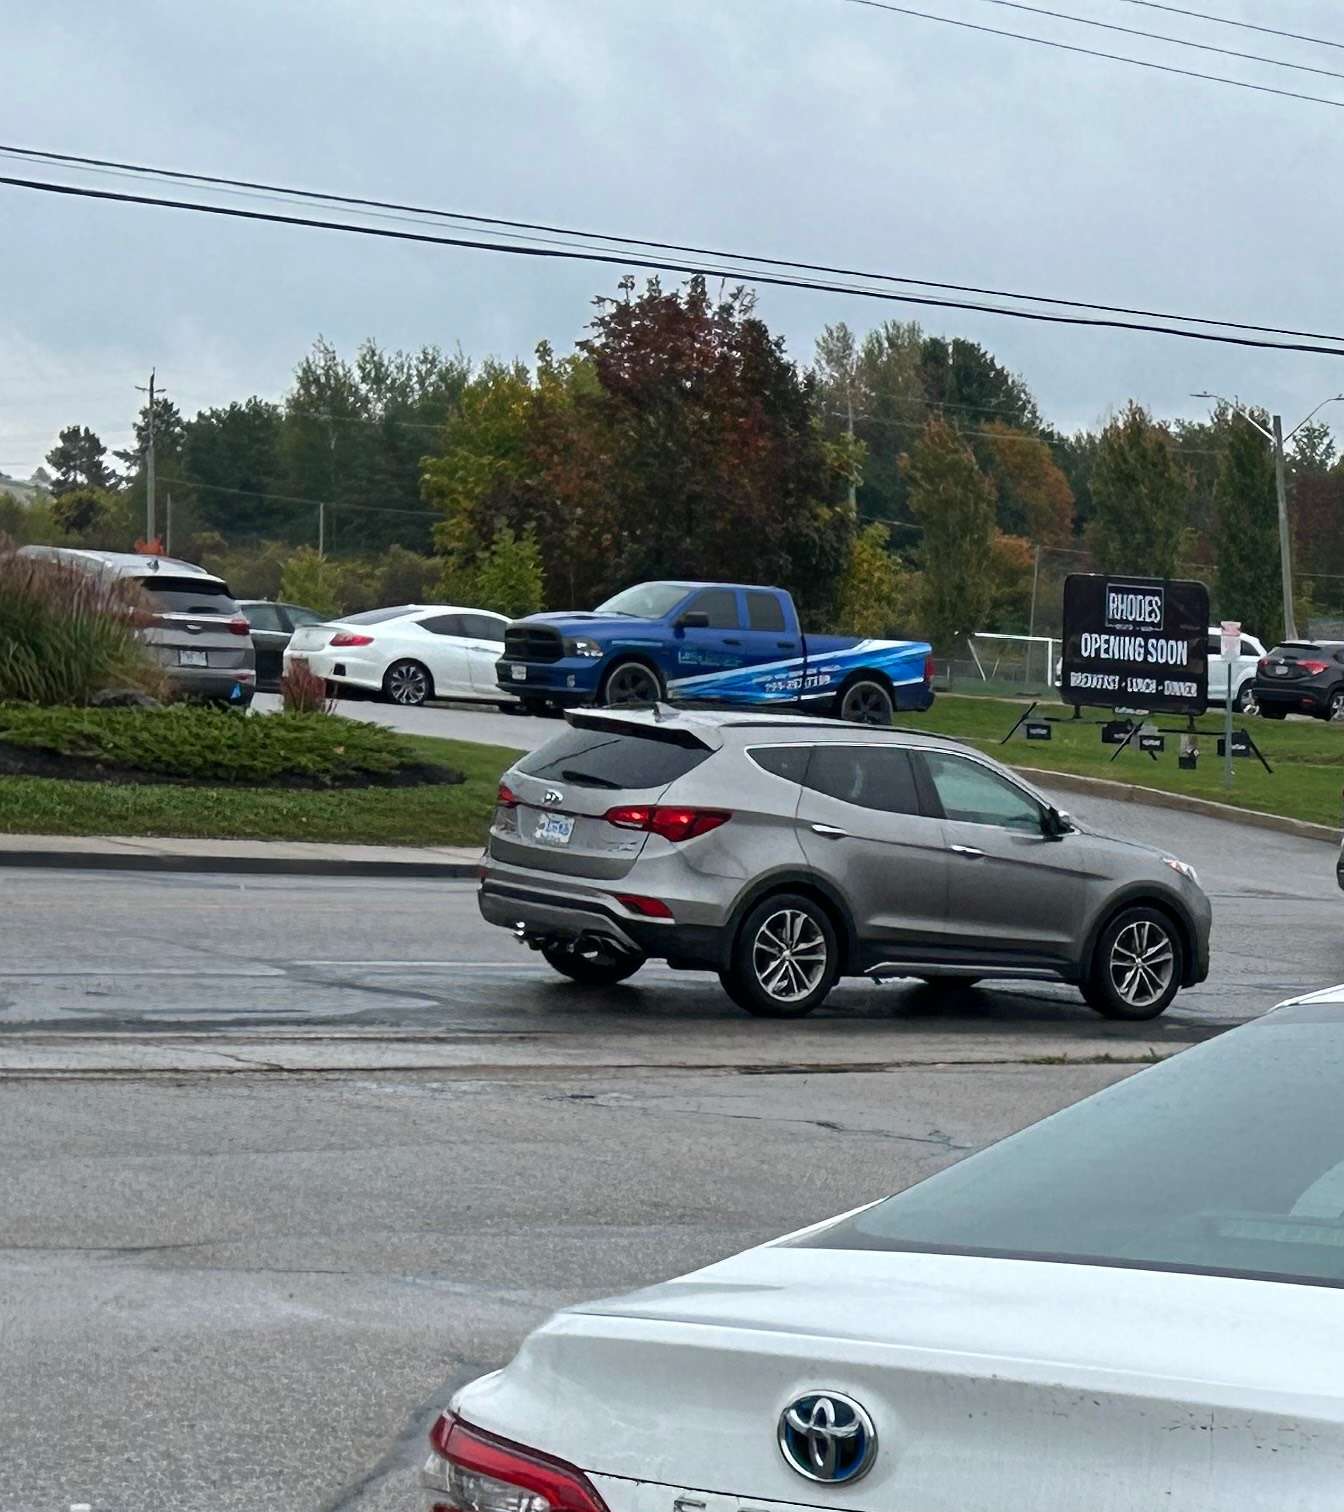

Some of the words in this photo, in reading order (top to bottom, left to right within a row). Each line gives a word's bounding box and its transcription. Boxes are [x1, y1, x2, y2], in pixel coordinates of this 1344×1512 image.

[1109, 592, 1161, 623] RHODES
[1080, 632, 1145, 662] OPENING
[1147, 638, 1188, 667] SOON
